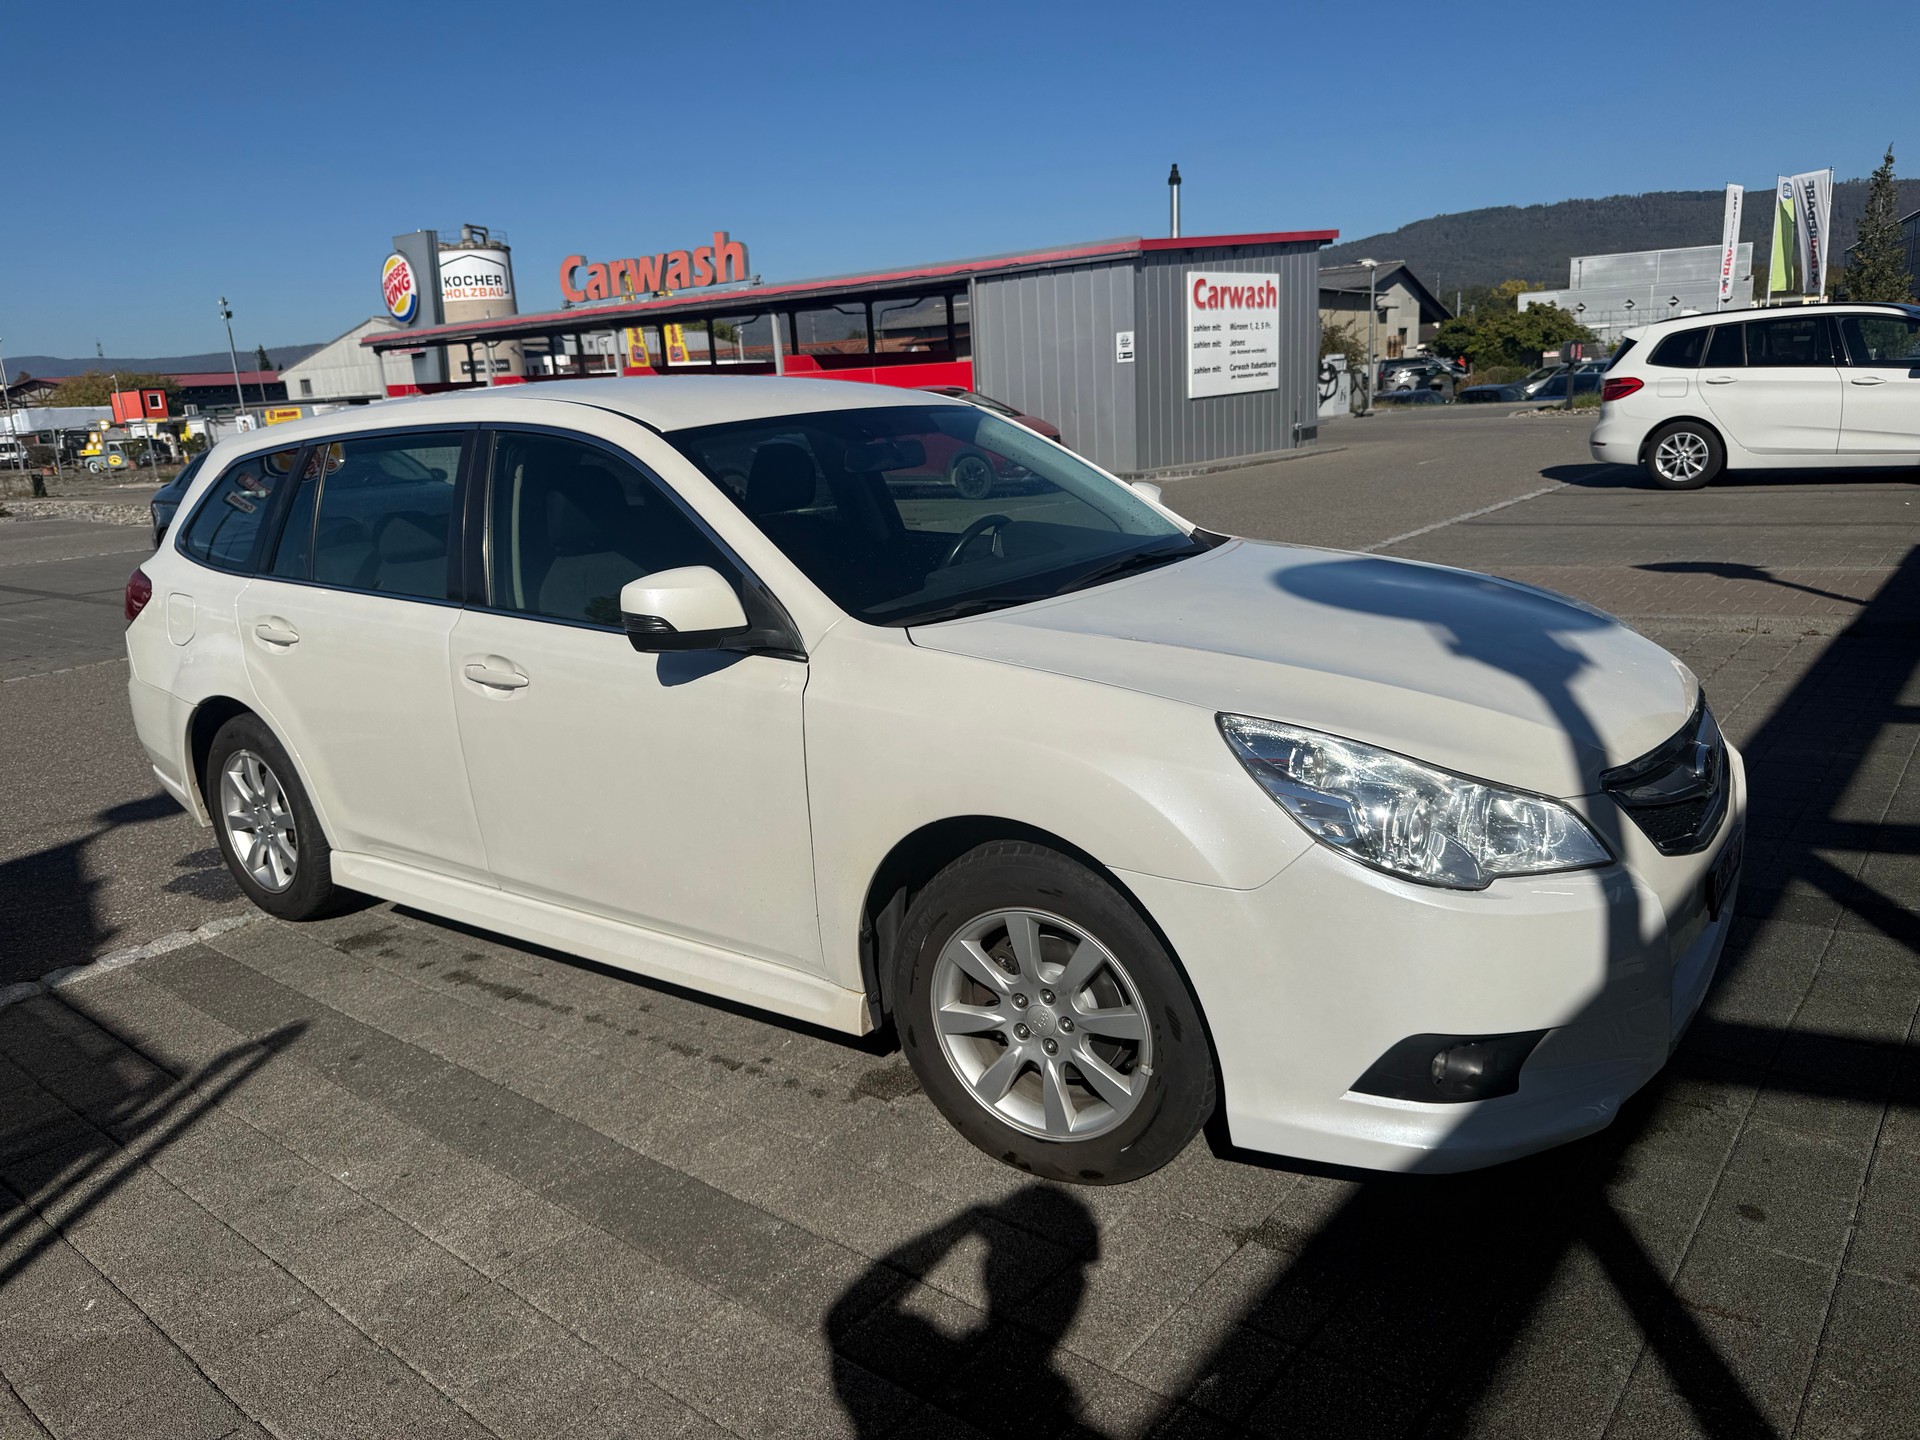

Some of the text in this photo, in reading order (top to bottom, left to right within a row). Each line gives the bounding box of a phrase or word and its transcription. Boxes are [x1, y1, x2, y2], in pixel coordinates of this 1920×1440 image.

[559, 231, 748, 303] Carwash
[384, 261, 408, 291] BURGER
[443, 275, 503, 288] KOCHER
[386, 272, 411, 311] KING
[444, 287, 504, 299] HOLZBAU
[1193, 278, 1277, 310] Carwash
[1193, 324, 1211, 332] zahlen
[1193, 341, 1211, 349] zahlen
[1193, 366, 1211, 374] zahlen
